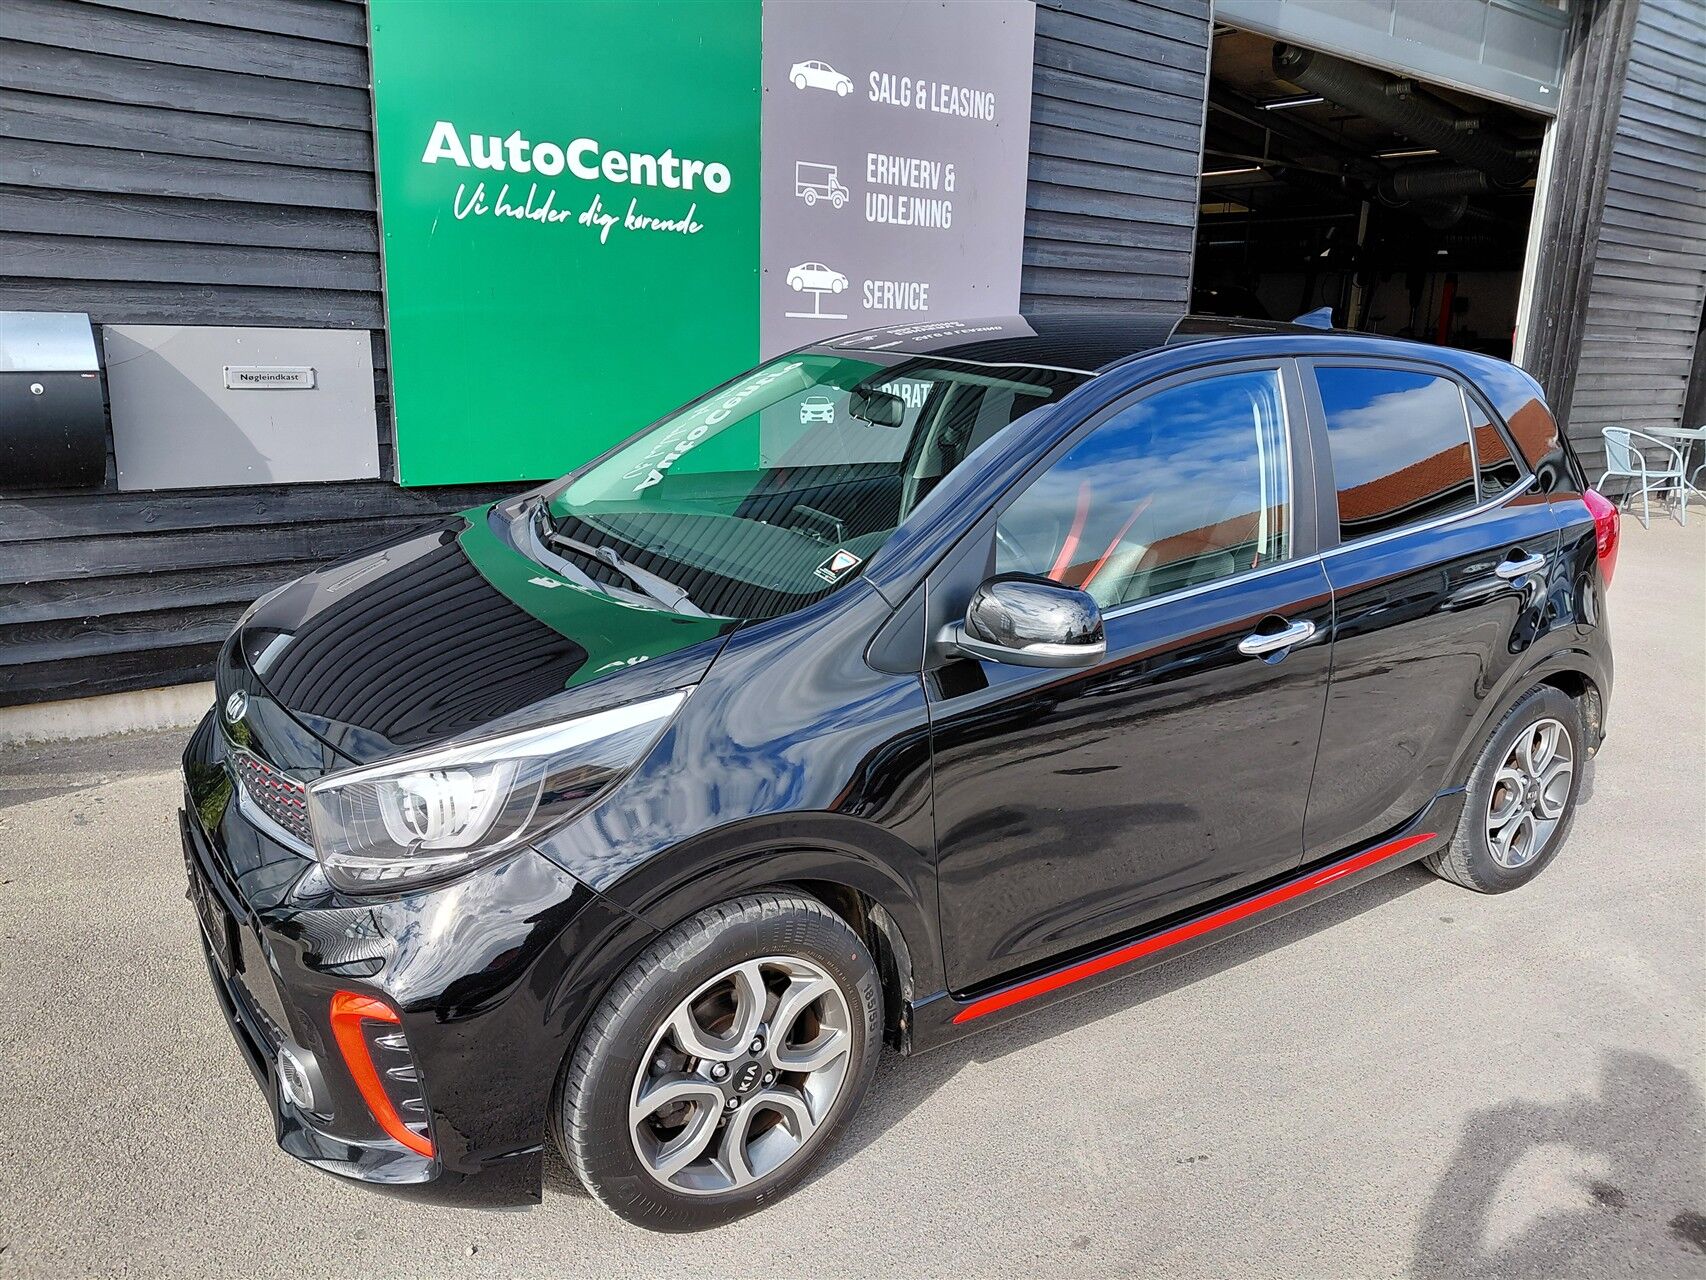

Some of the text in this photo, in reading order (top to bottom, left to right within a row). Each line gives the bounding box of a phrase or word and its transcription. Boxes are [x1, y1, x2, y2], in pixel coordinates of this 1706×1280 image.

[868, 70, 995, 121] SALG & LEASING
[421, 120, 732, 194] AutoCentro
[867, 152, 955, 192] ERHVERV &
[454, 182, 489, 220] Vi
[494, 182, 572, 224] holder
[578, 193, 620, 245] dig
[865, 192, 952, 229] UDLEJNING
[863, 279, 929, 311] SERVICE
[240, 373, 299, 382] Nøgleindkast
[738, 1065, 758, 1091] KIA
